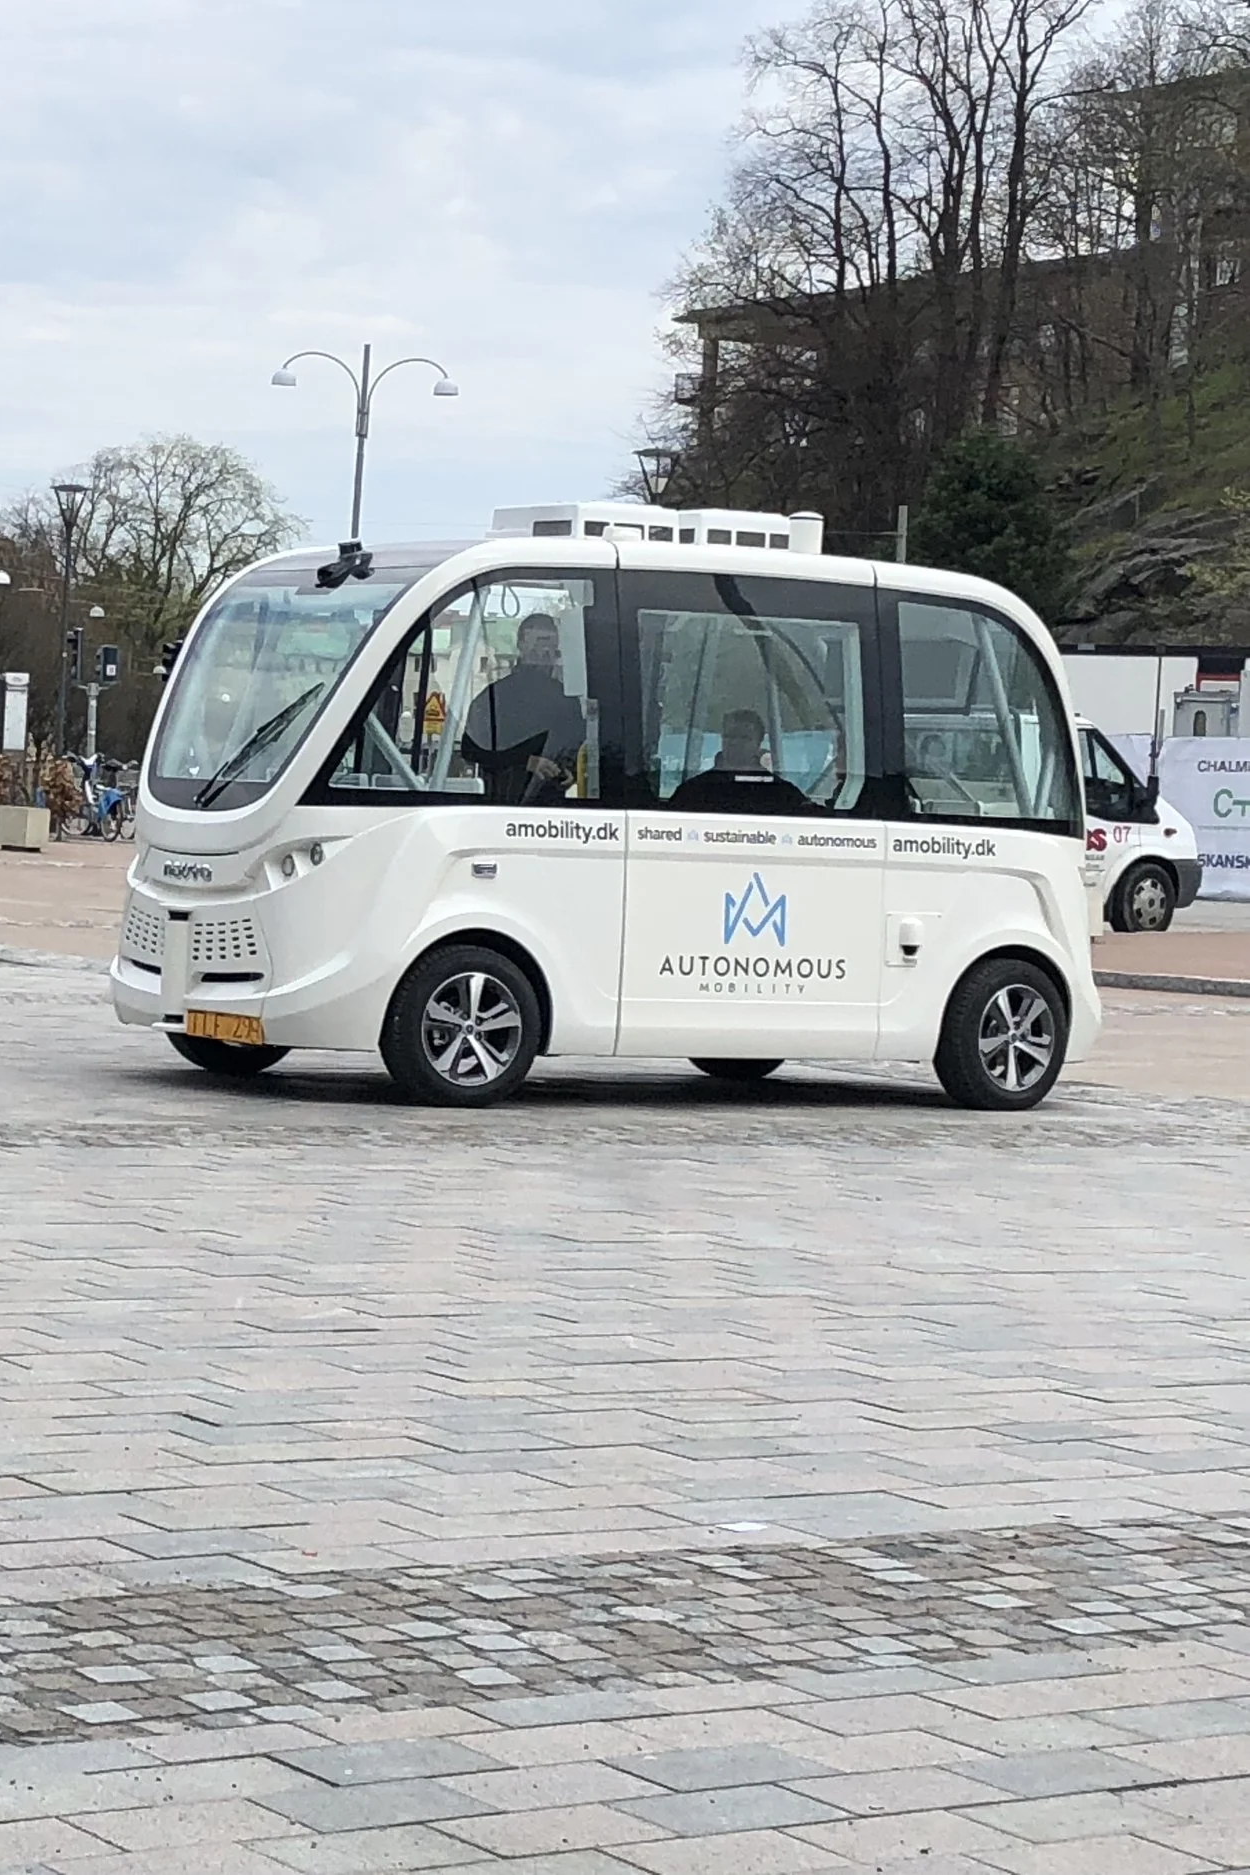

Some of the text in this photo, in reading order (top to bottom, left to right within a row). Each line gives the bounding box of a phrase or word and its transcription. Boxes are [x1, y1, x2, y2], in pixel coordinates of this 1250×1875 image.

[505, 820, 620, 844] amobility.dk
[637, 827, 878, 849] shared sustainable autonomous
[1113, 825, 1132, 843] 07
[892, 836, 997, 860] amobility.dk
[659, 955, 847, 980] AUTONOMOUS
[699, 982, 806, 995] MOBILITY
